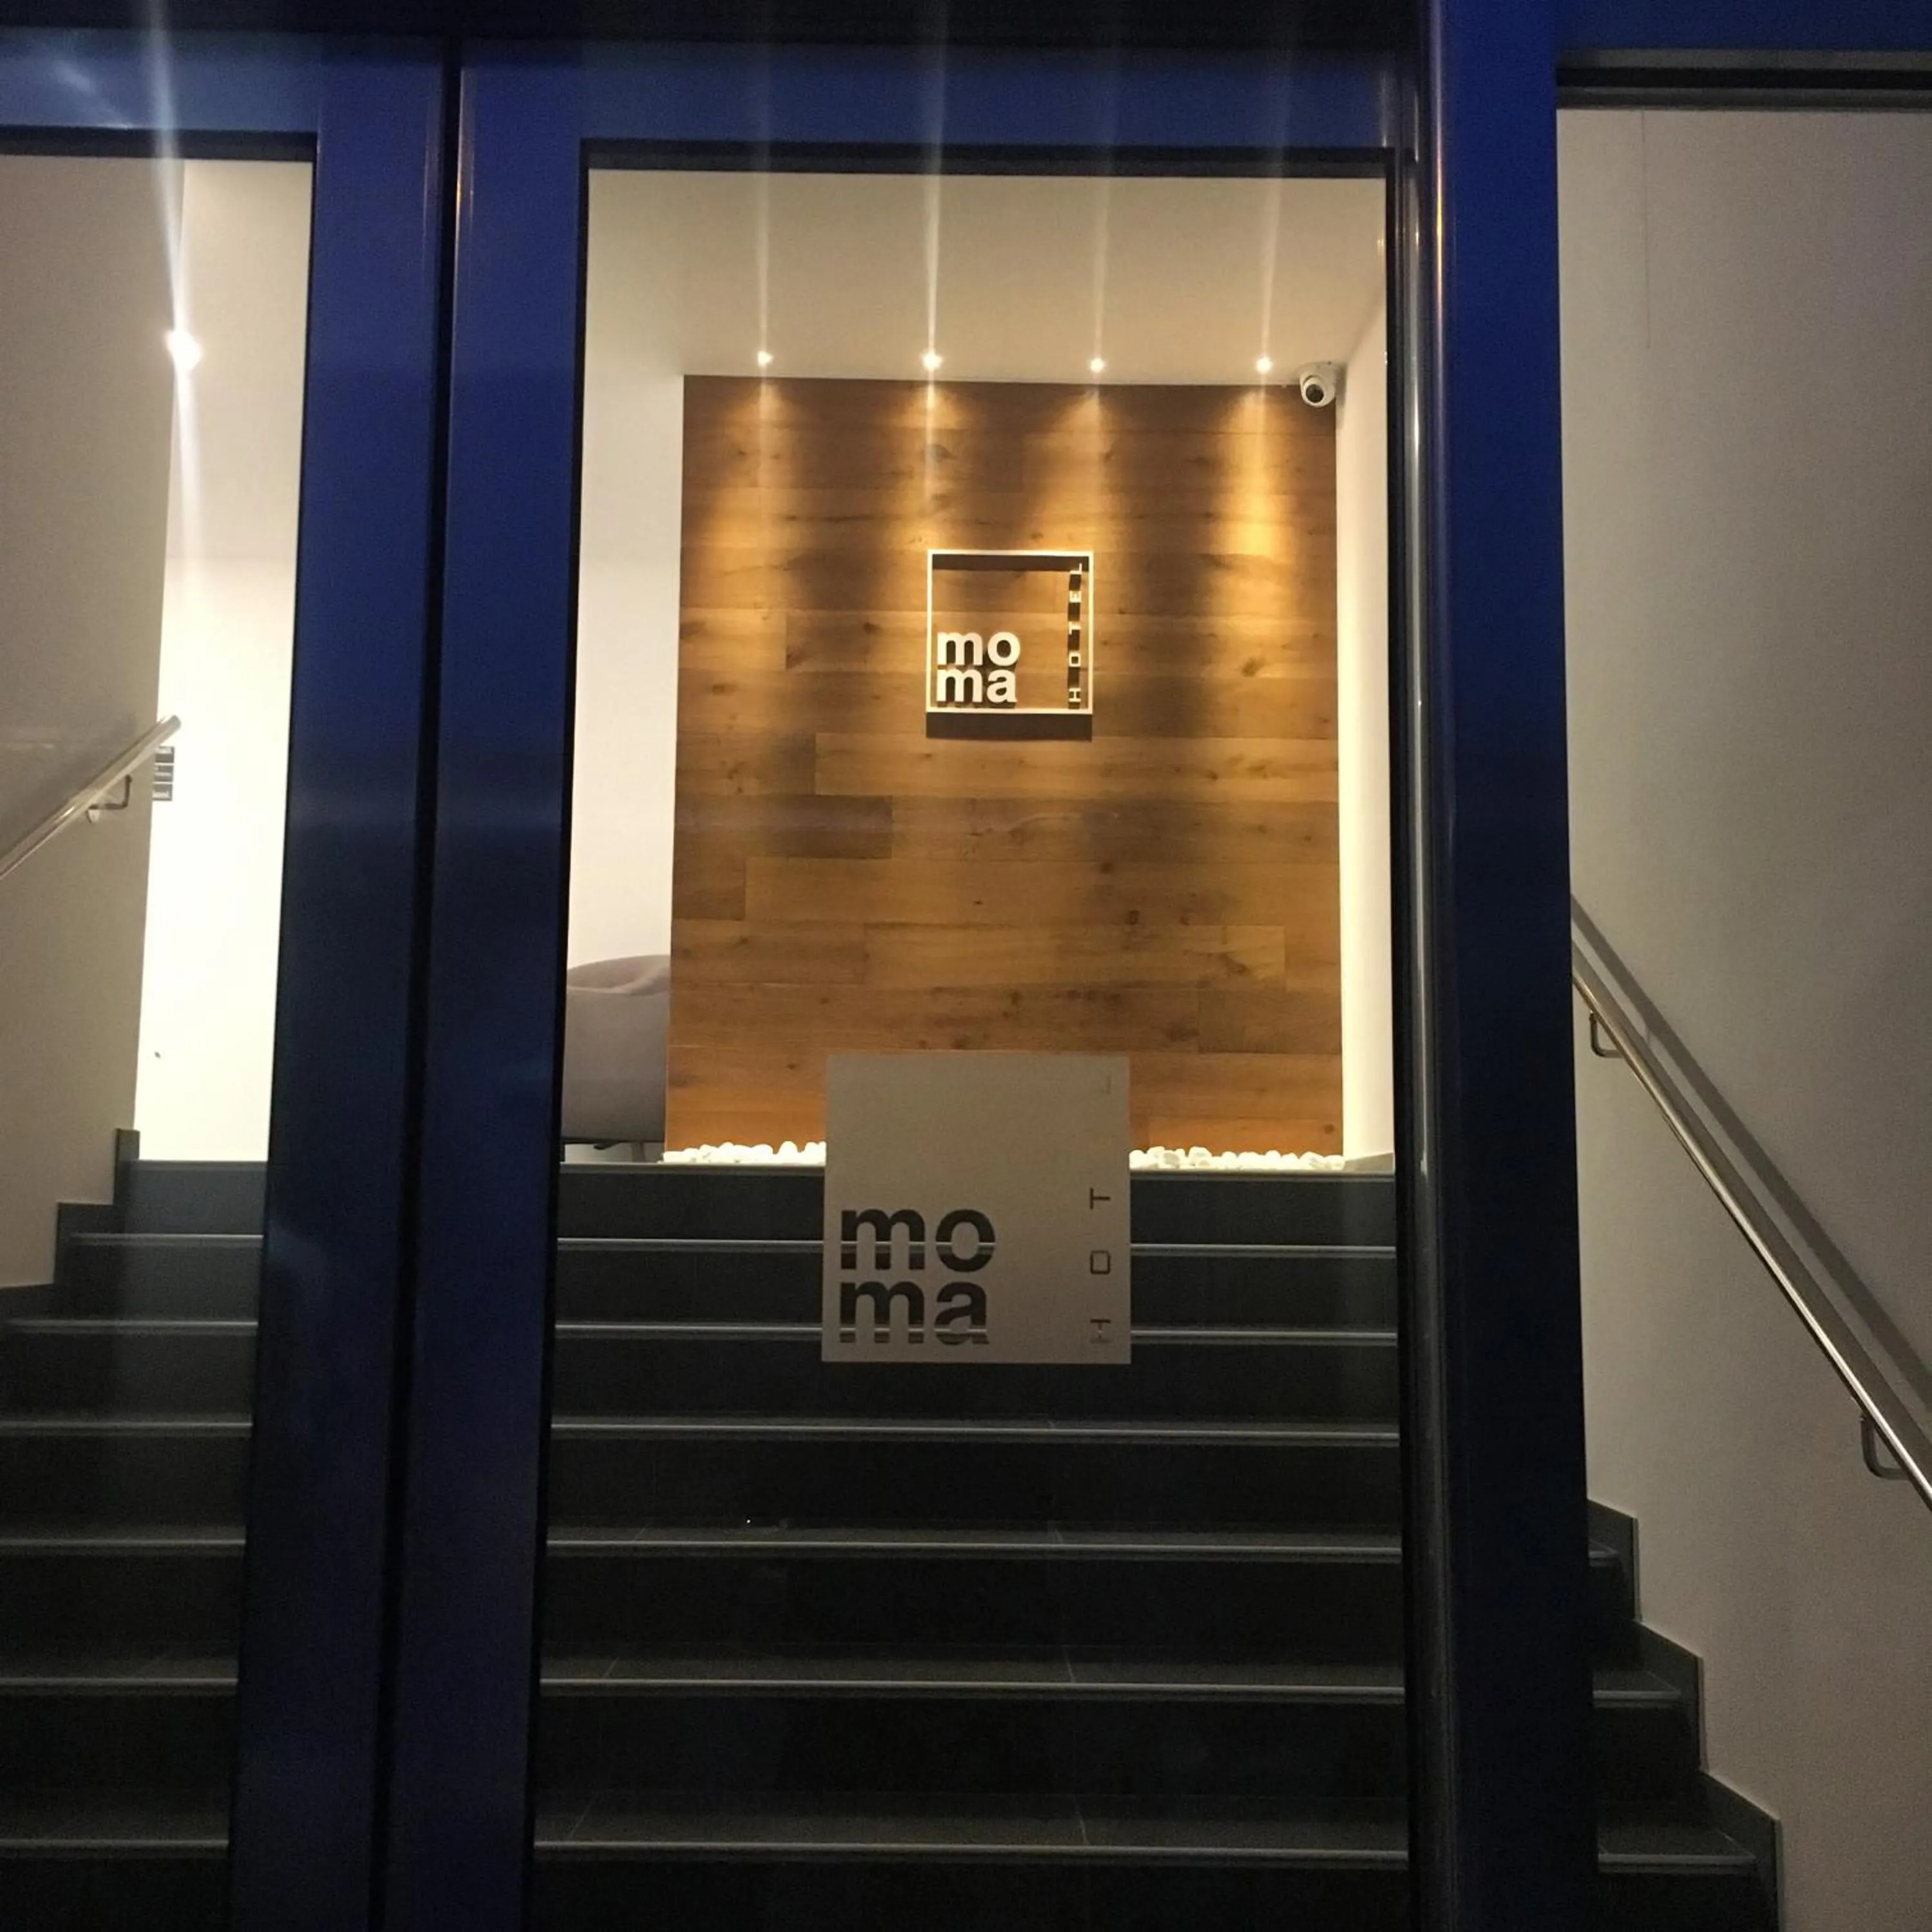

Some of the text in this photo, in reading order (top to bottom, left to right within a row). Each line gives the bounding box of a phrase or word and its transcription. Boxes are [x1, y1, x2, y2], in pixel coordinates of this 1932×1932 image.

[936, 631, 1021, 667] mo
[1067, 562, 1083, 703] HOTEL
[936, 668, 1018, 704] ma
[840, 1208, 996, 1273] mo
[1090, 1074, 1112, 1345] HOTL
[838, 1281, 990, 1346] ma
